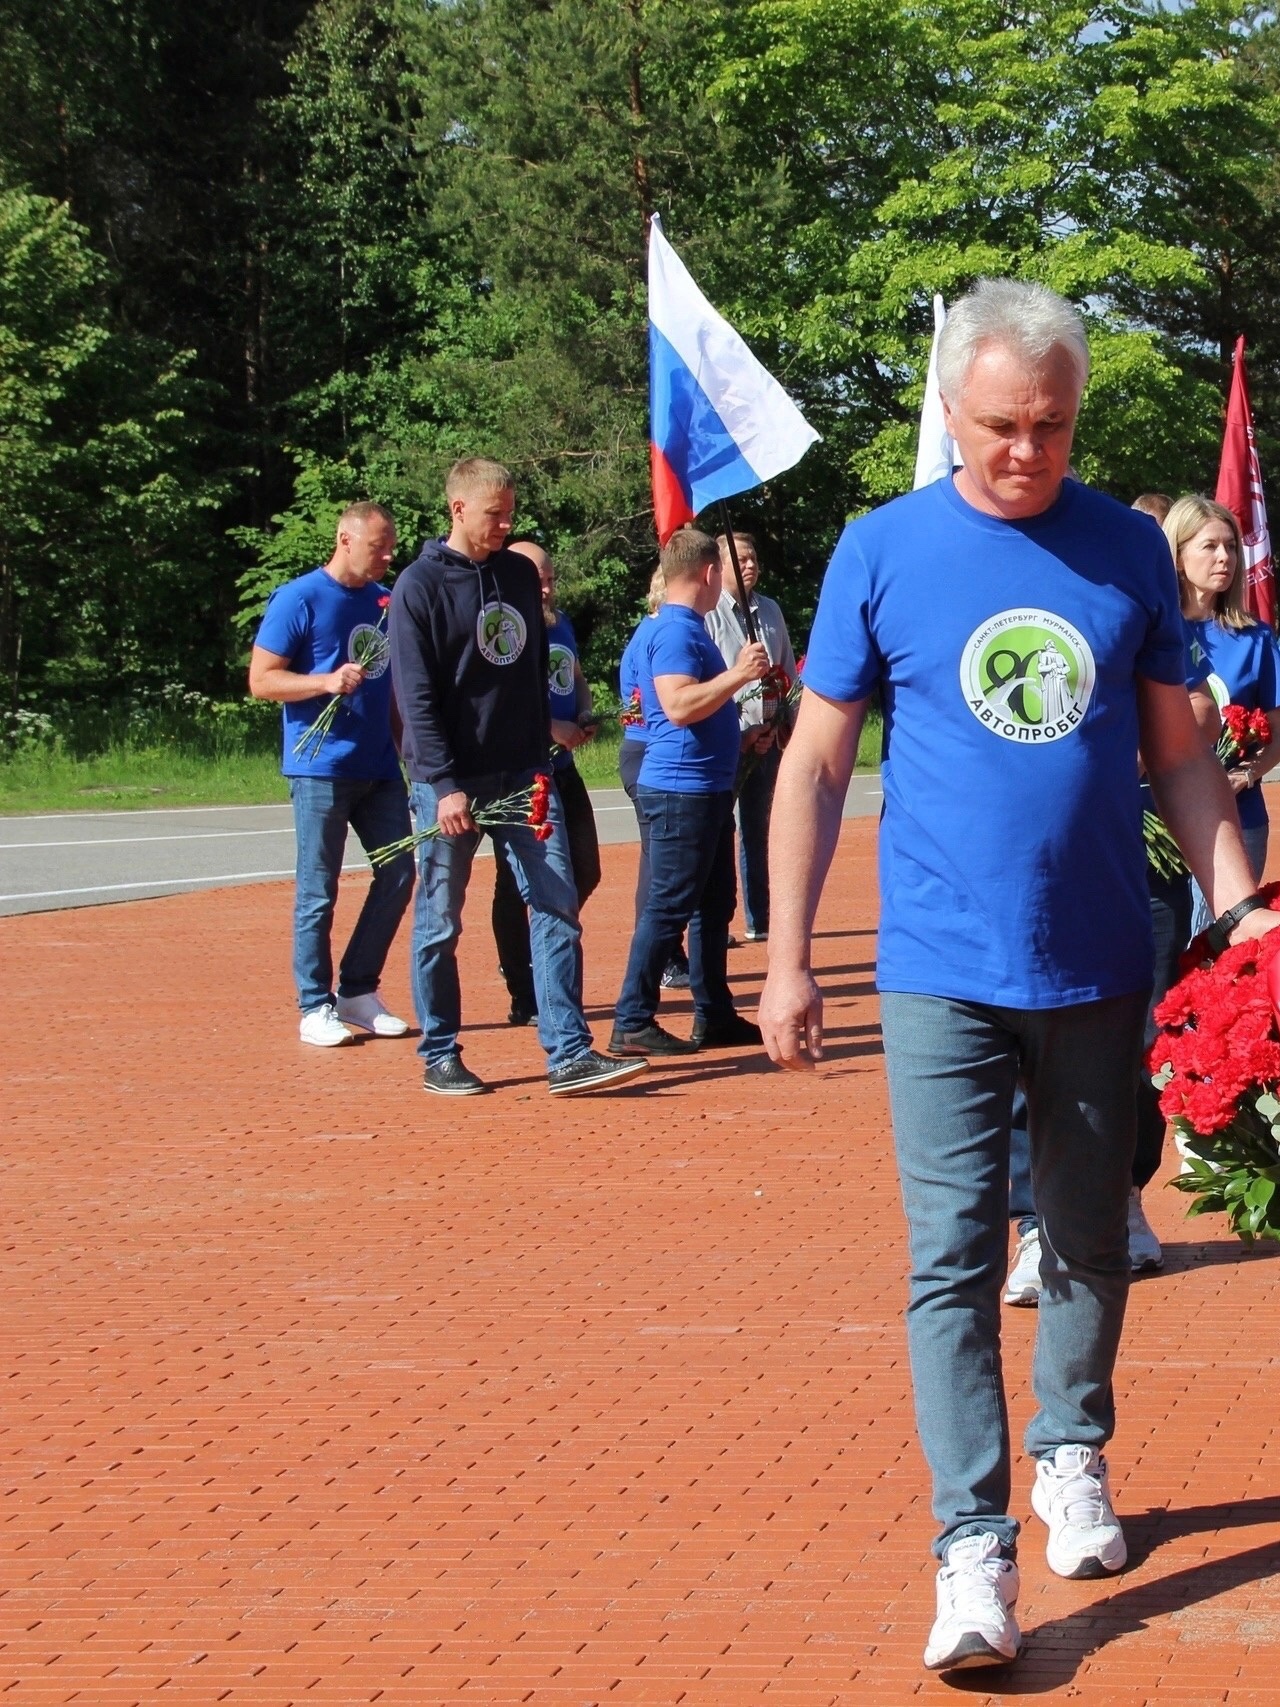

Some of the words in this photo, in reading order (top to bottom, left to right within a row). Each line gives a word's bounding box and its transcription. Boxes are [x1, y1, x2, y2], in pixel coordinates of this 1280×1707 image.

[973, 614, 1039, 649] САНКТ-ПЕТЕРБУРГ
[1042, 617, 1081, 648] МУРМАНСК
[970, 698, 1083, 741] АВТОПРОБЕГ
